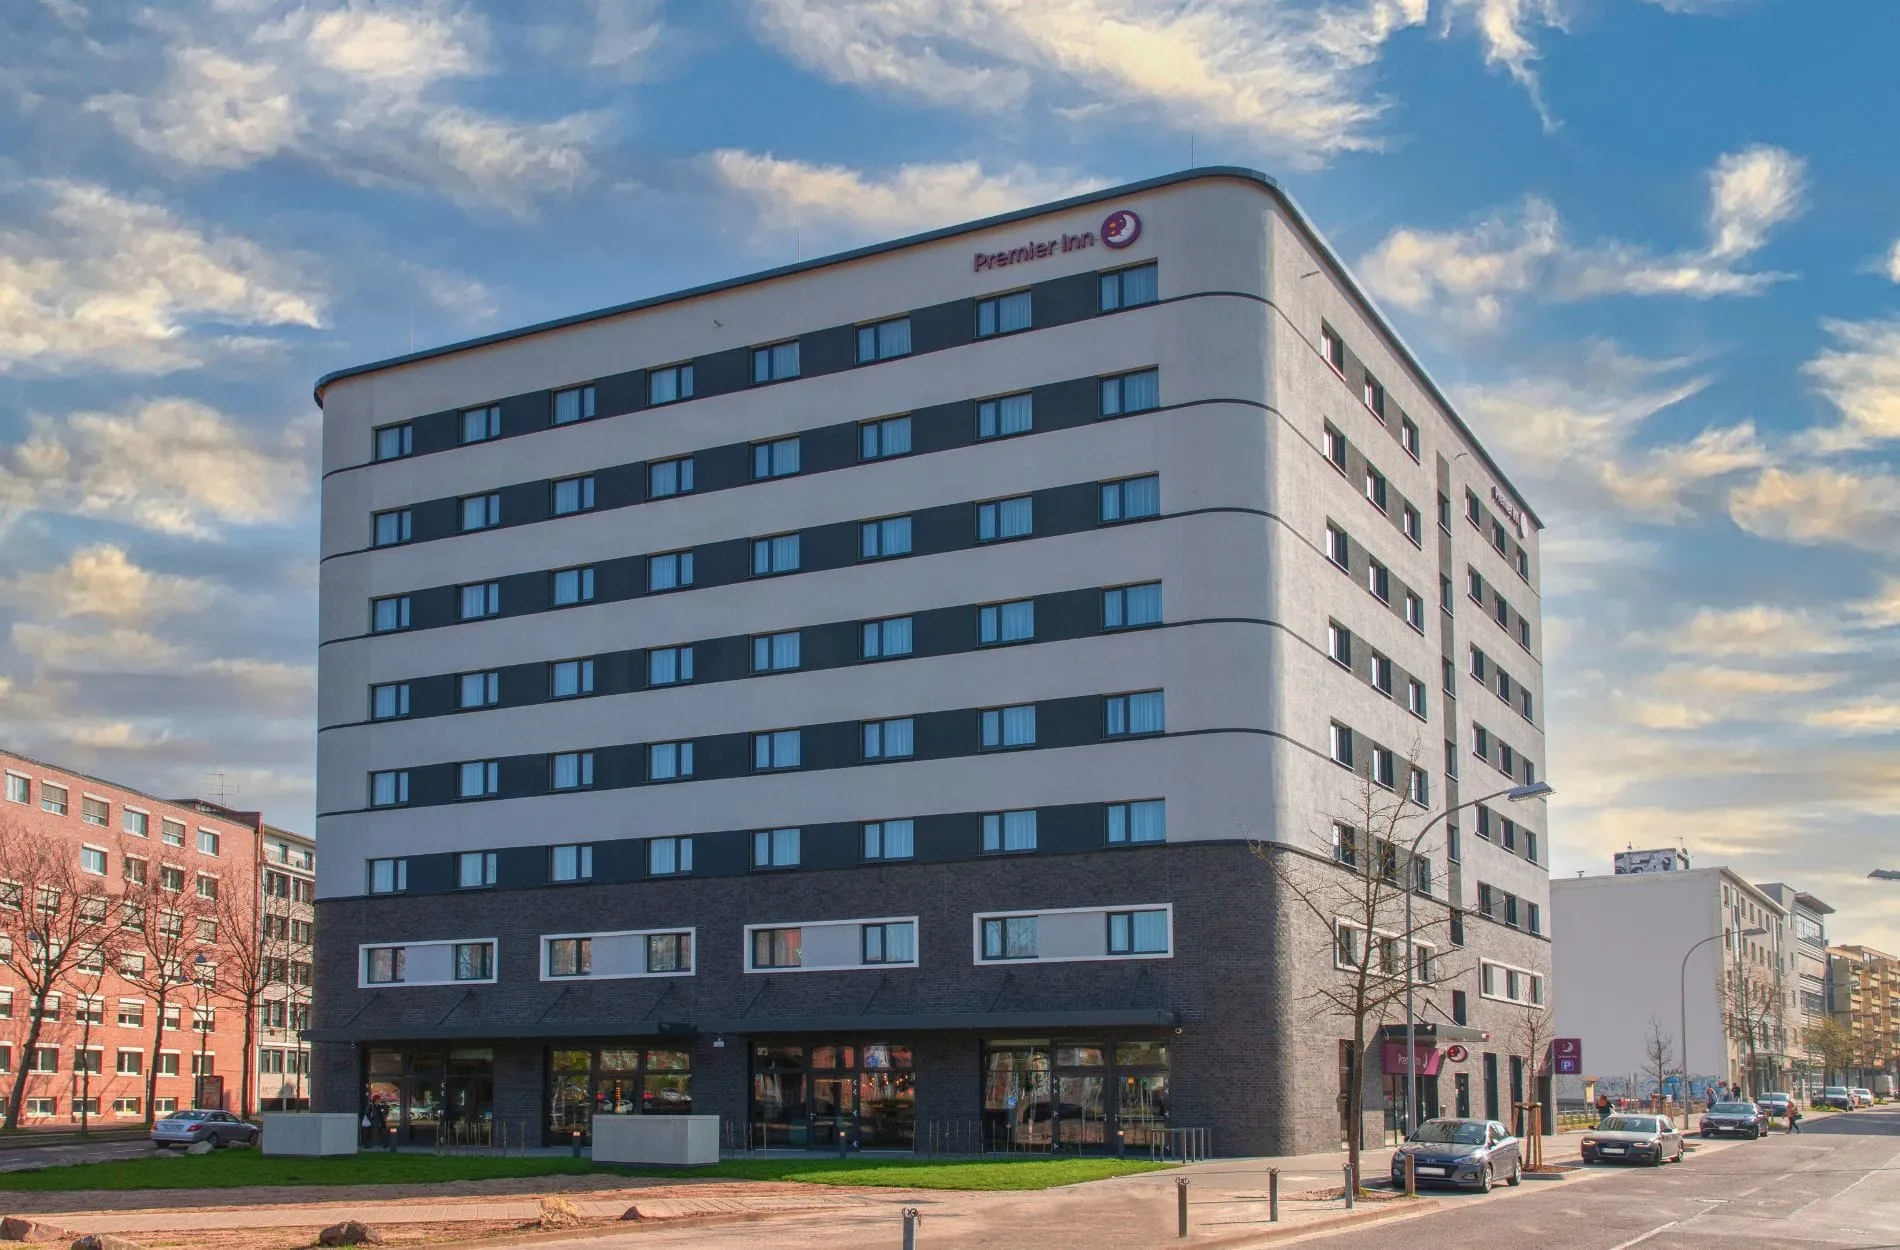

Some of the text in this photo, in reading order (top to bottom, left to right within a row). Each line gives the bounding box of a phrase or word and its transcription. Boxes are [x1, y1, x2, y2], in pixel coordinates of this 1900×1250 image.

[974, 231, 1094, 272] Premier Inn
[1563, 1061, 1572, 1070] P
